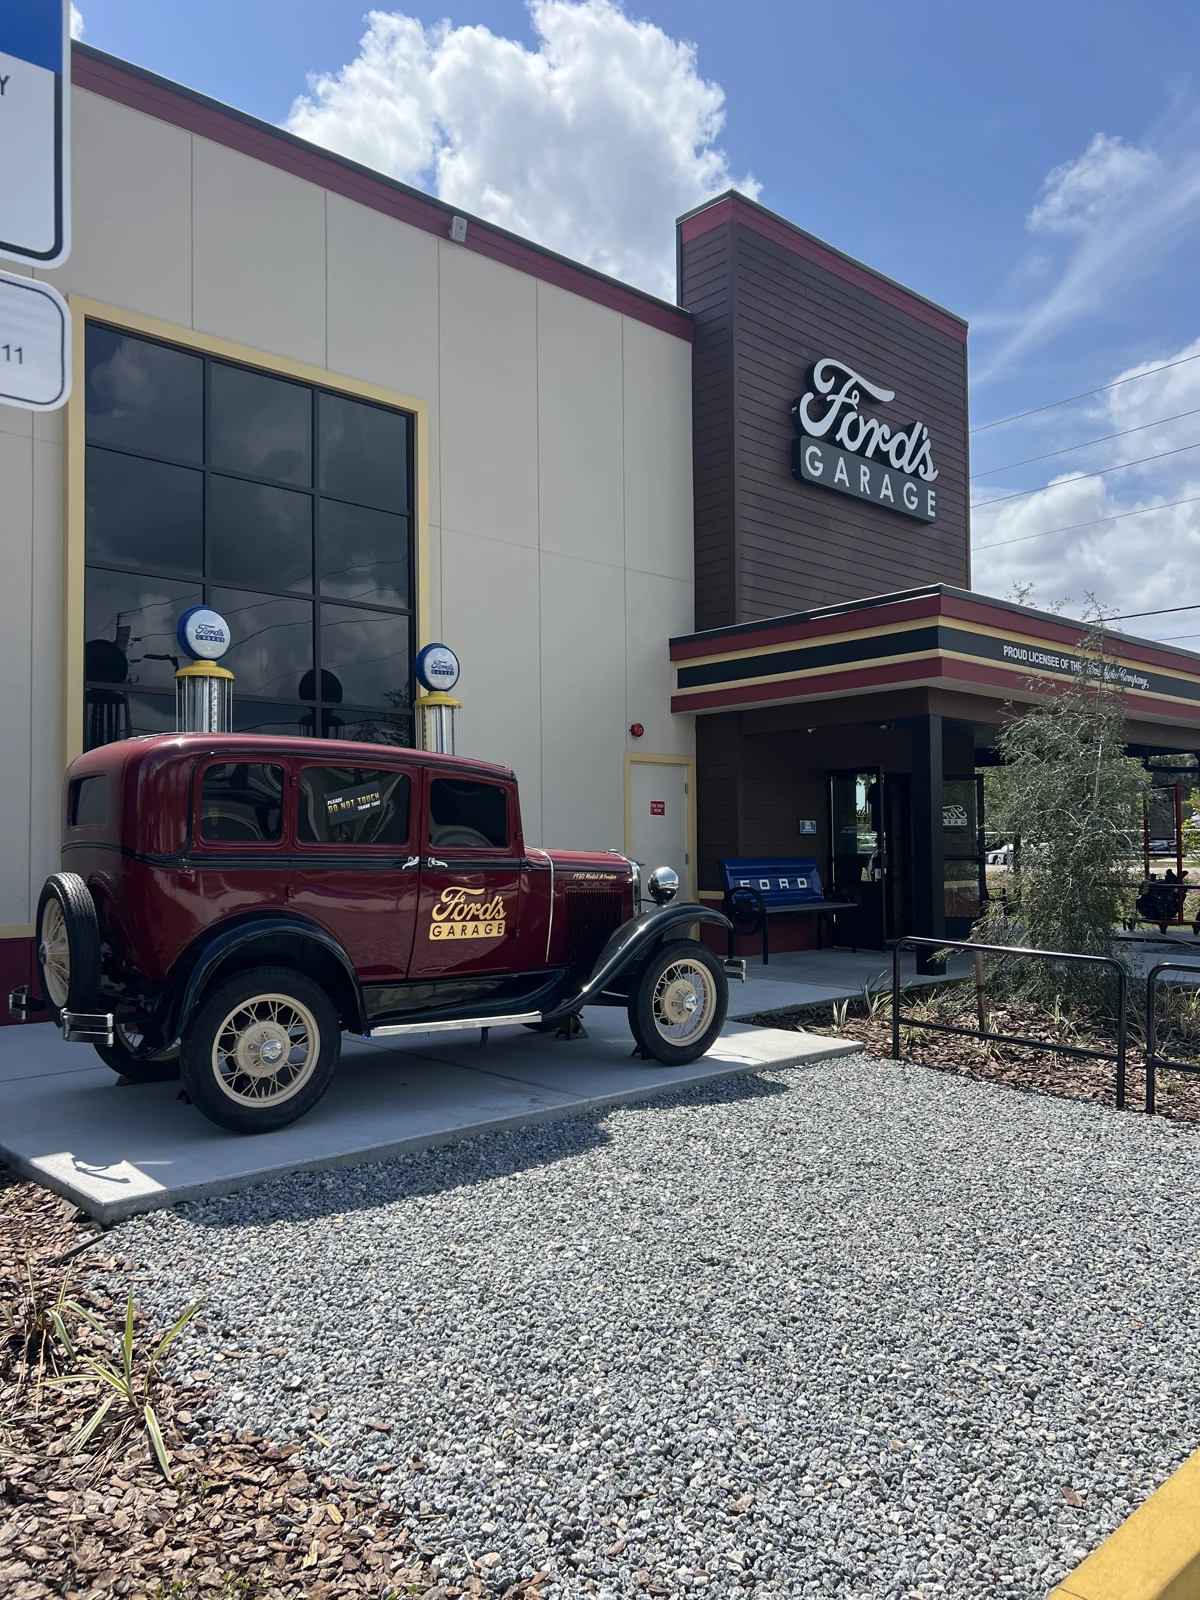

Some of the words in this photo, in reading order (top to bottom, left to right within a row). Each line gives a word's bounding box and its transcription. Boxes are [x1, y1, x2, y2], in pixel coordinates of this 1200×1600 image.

[800, 358, 919, 482] Ford's
[805, 445, 936, 517] GARAGE
[195, 623, 225, 637] Ford's
[1003, 645, 1027, 661] PROUD
[1028, 651, 1060, 668] LICENSEE
[1060, 658, 1070, 670] OF
[327, 803, 339, 814] DO
[340, 799, 354, 810] NOT
[357, 792, 380, 805] TOUCH
[740, 877, 808, 890] FORD
[431, 886, 507, 922] Ford's
[432, 923, 503, 938] GARAGE
